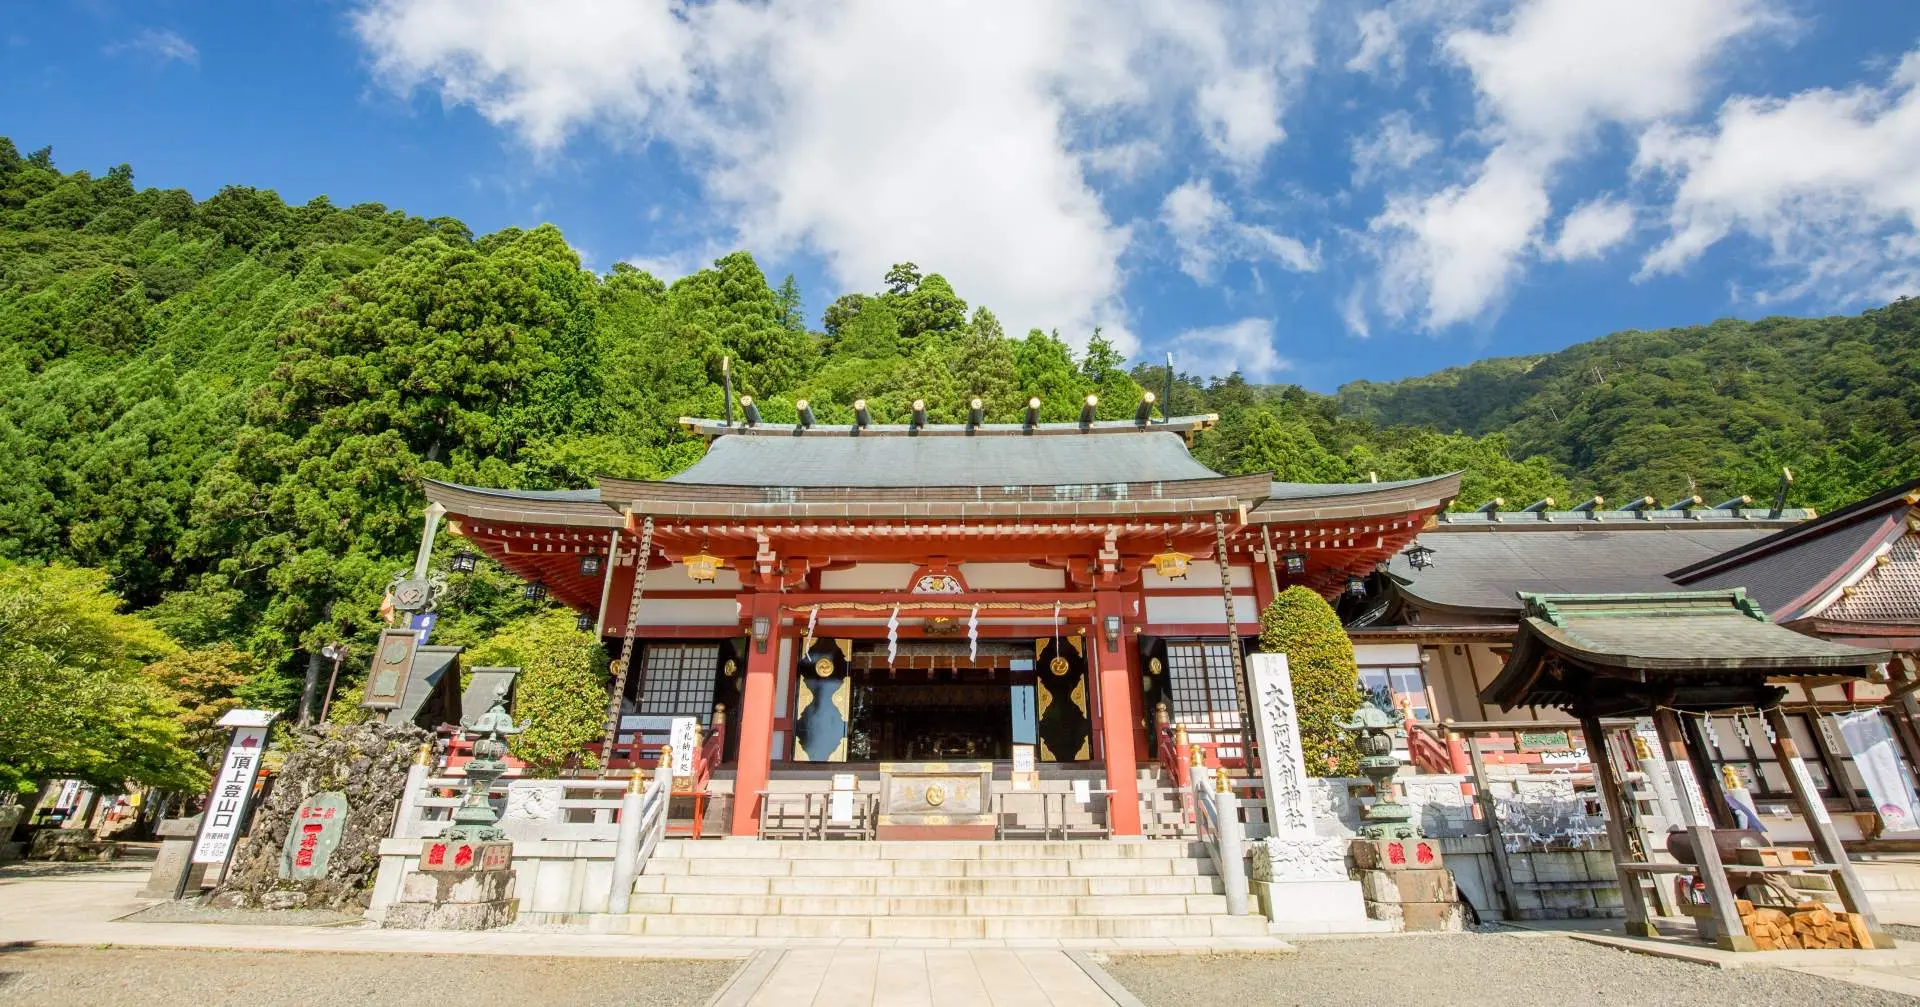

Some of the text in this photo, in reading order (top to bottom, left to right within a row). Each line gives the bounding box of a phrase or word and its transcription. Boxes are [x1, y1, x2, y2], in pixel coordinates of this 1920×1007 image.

[212, 756, 252, 828] 頂上登山口
